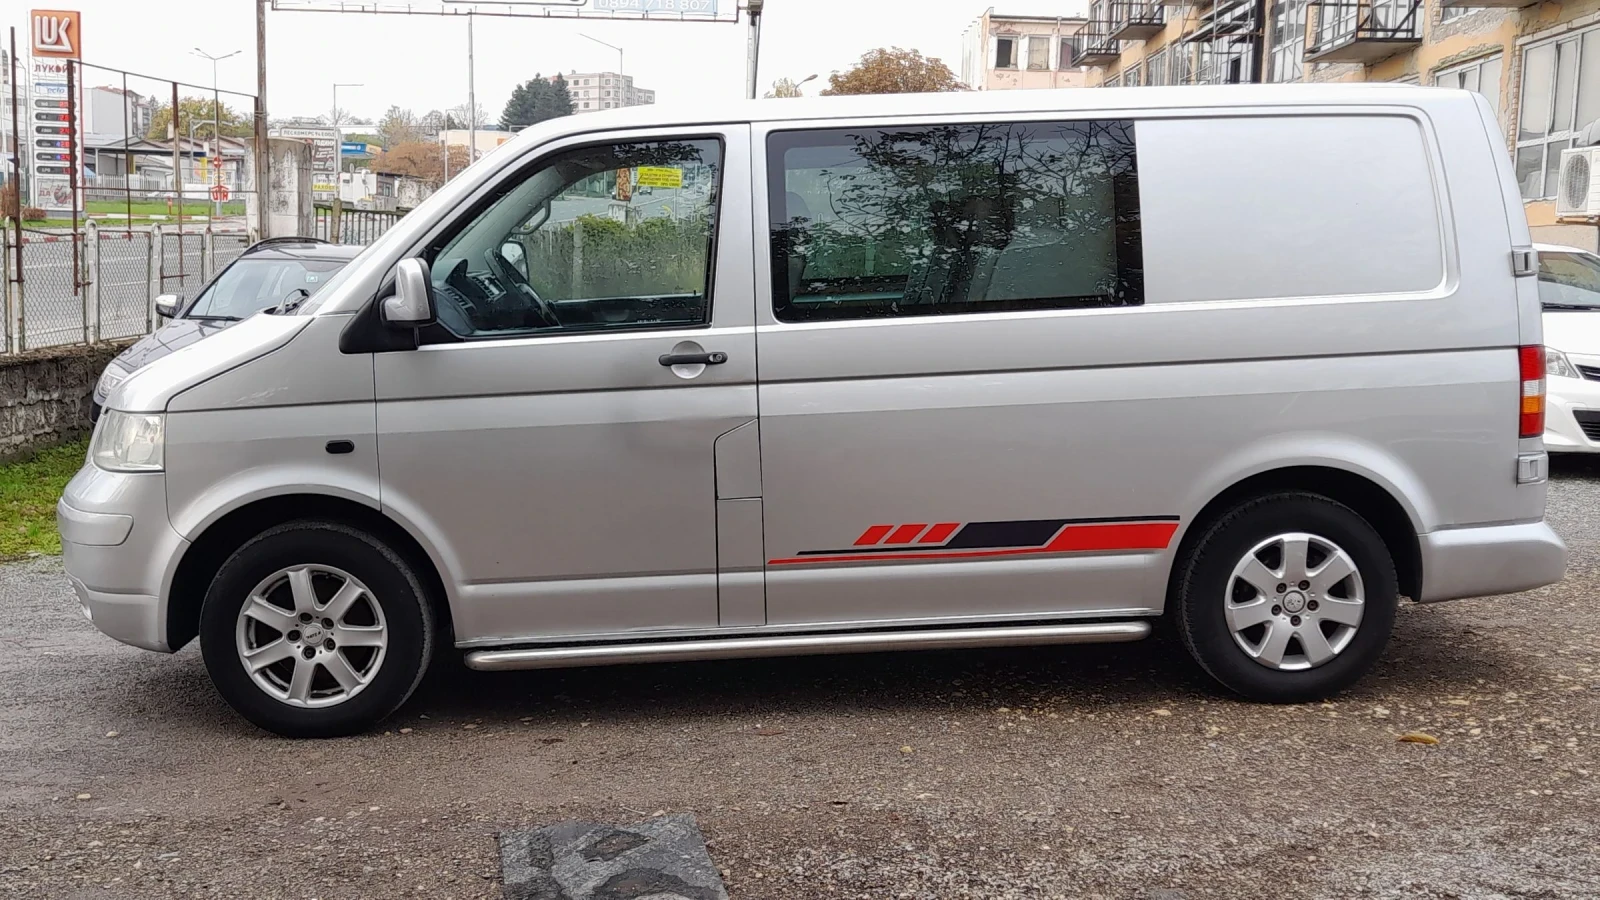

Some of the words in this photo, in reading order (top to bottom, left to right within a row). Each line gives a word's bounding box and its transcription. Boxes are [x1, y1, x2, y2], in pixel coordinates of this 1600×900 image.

[598, 0, 639, 8] 0894
[645, 0, 675, 10] 718
[680, 0, 710, 10] 807
